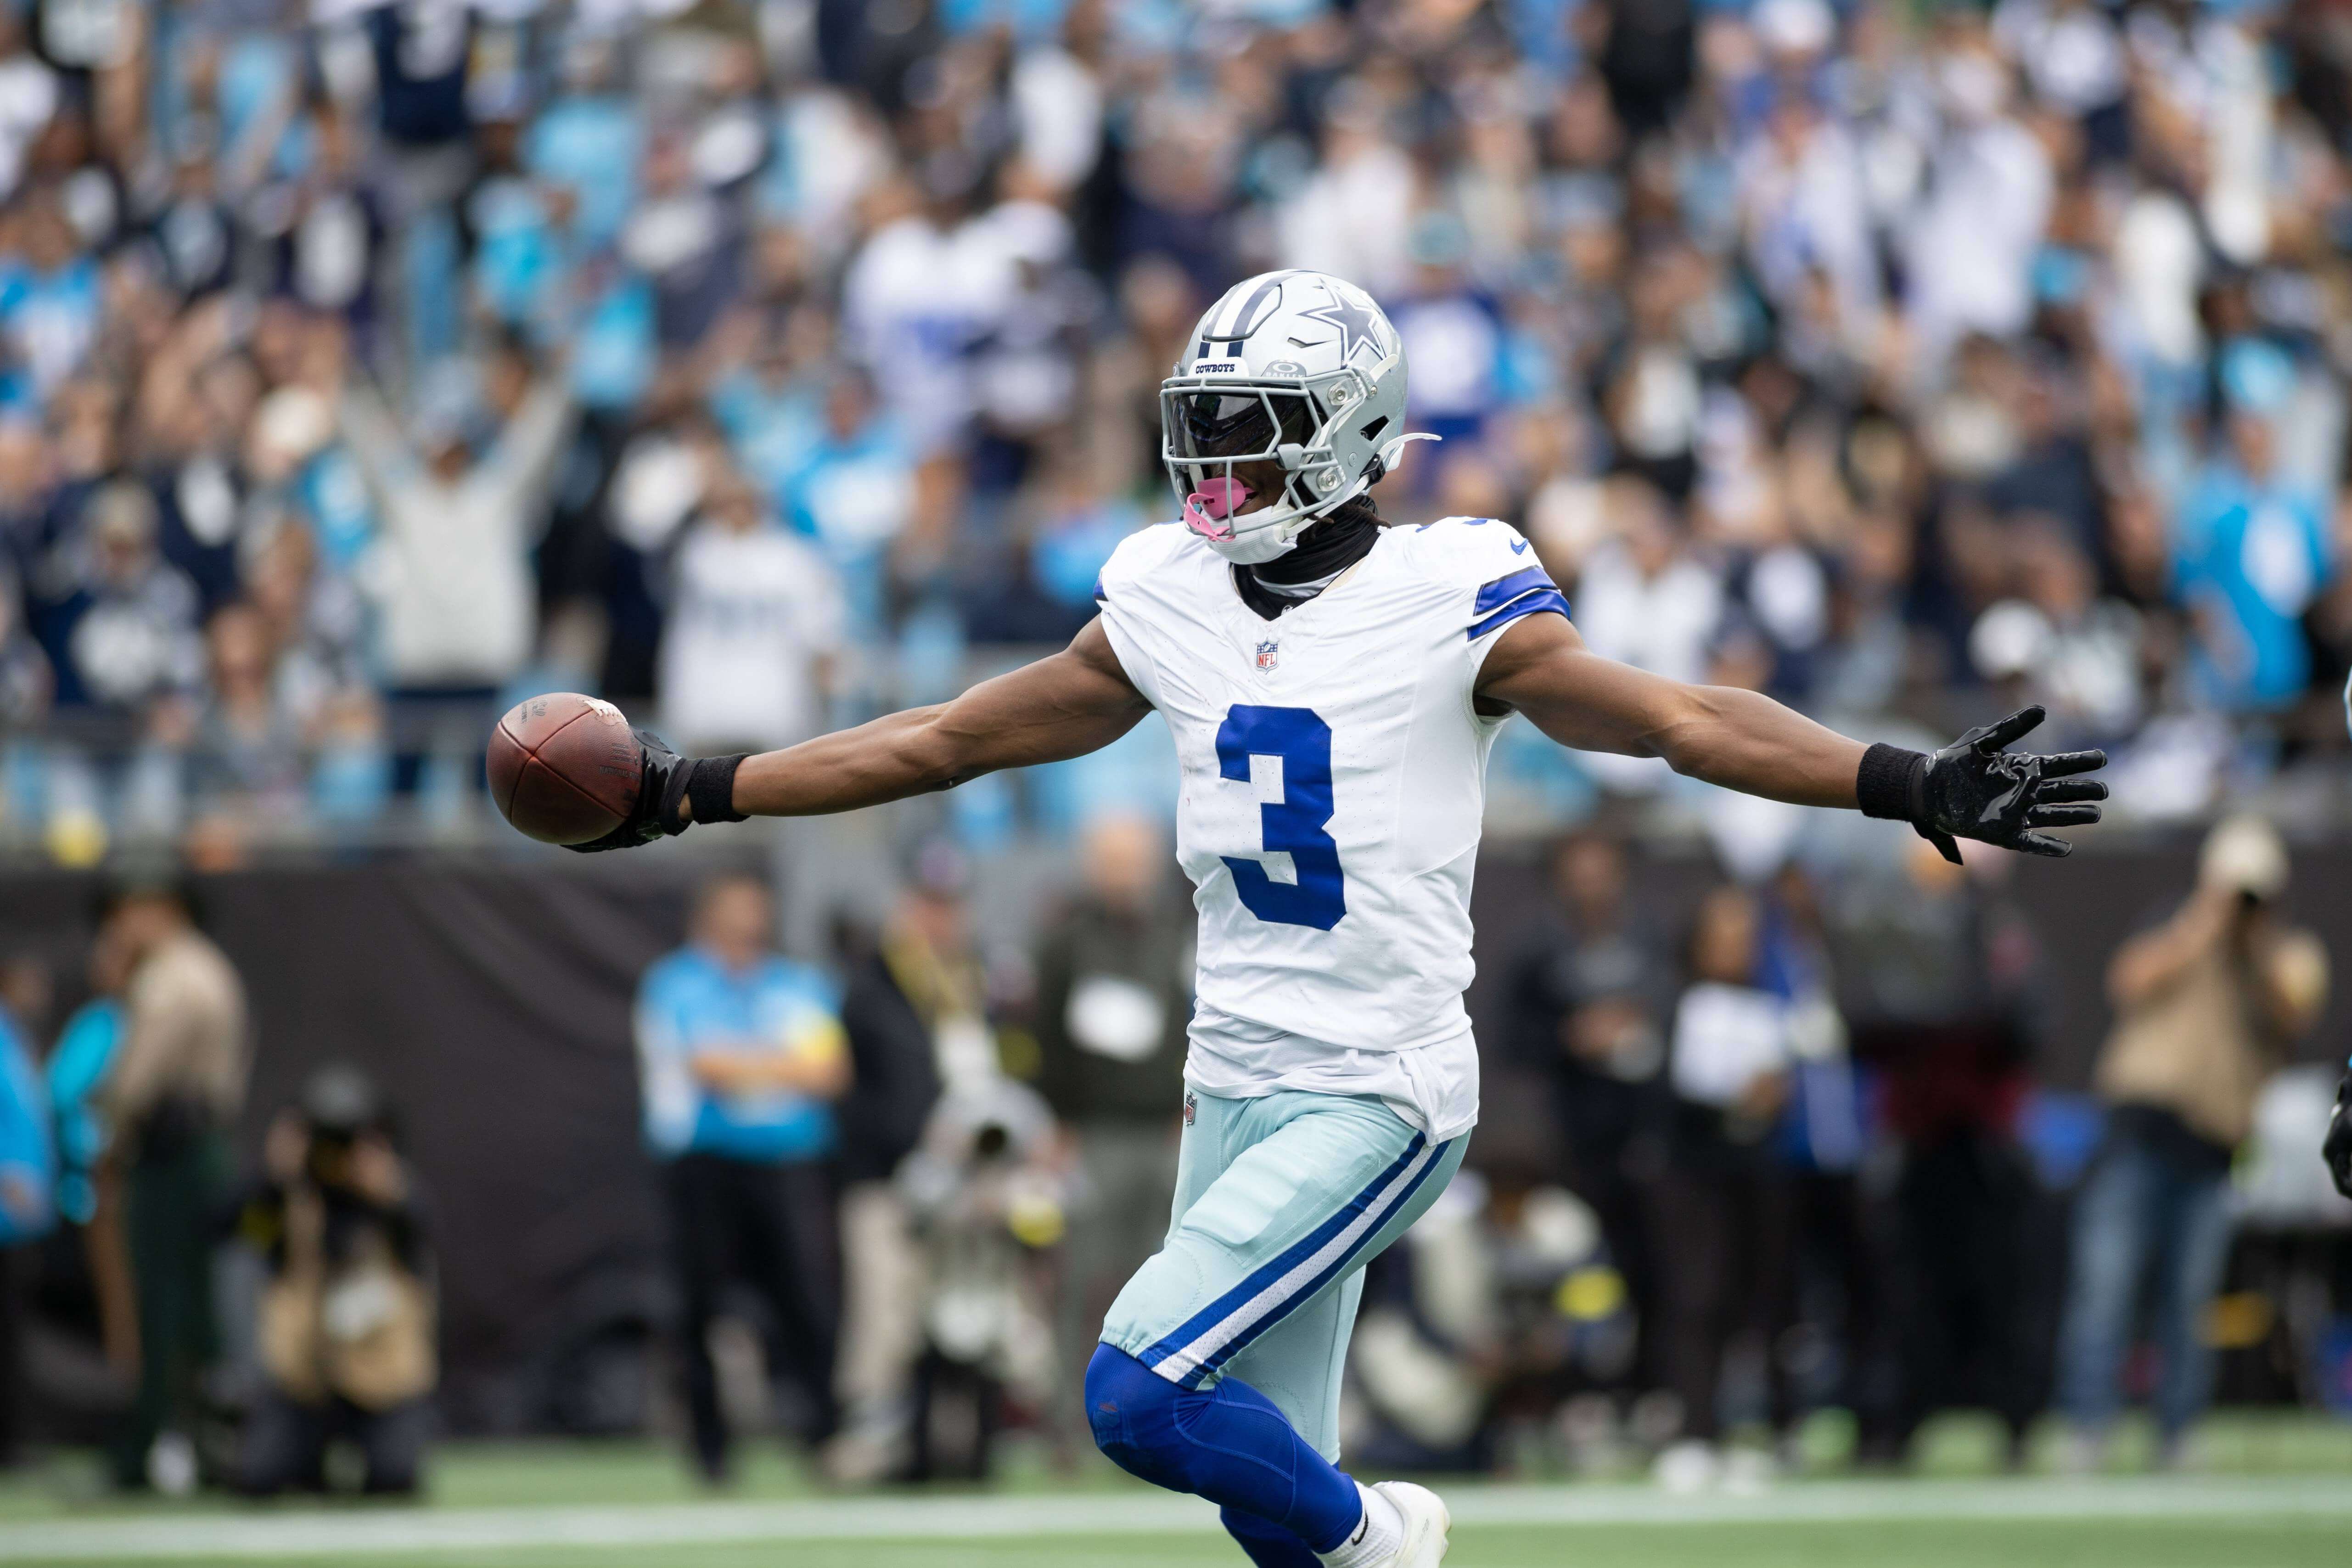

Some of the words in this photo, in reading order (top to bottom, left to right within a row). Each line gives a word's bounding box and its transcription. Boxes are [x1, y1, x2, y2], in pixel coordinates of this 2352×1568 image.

[1196, 364, 1235, 374] COWBOYS
[1258, 653, 1275, 666] NFL
[1215, 703, 1347, 931] 3
